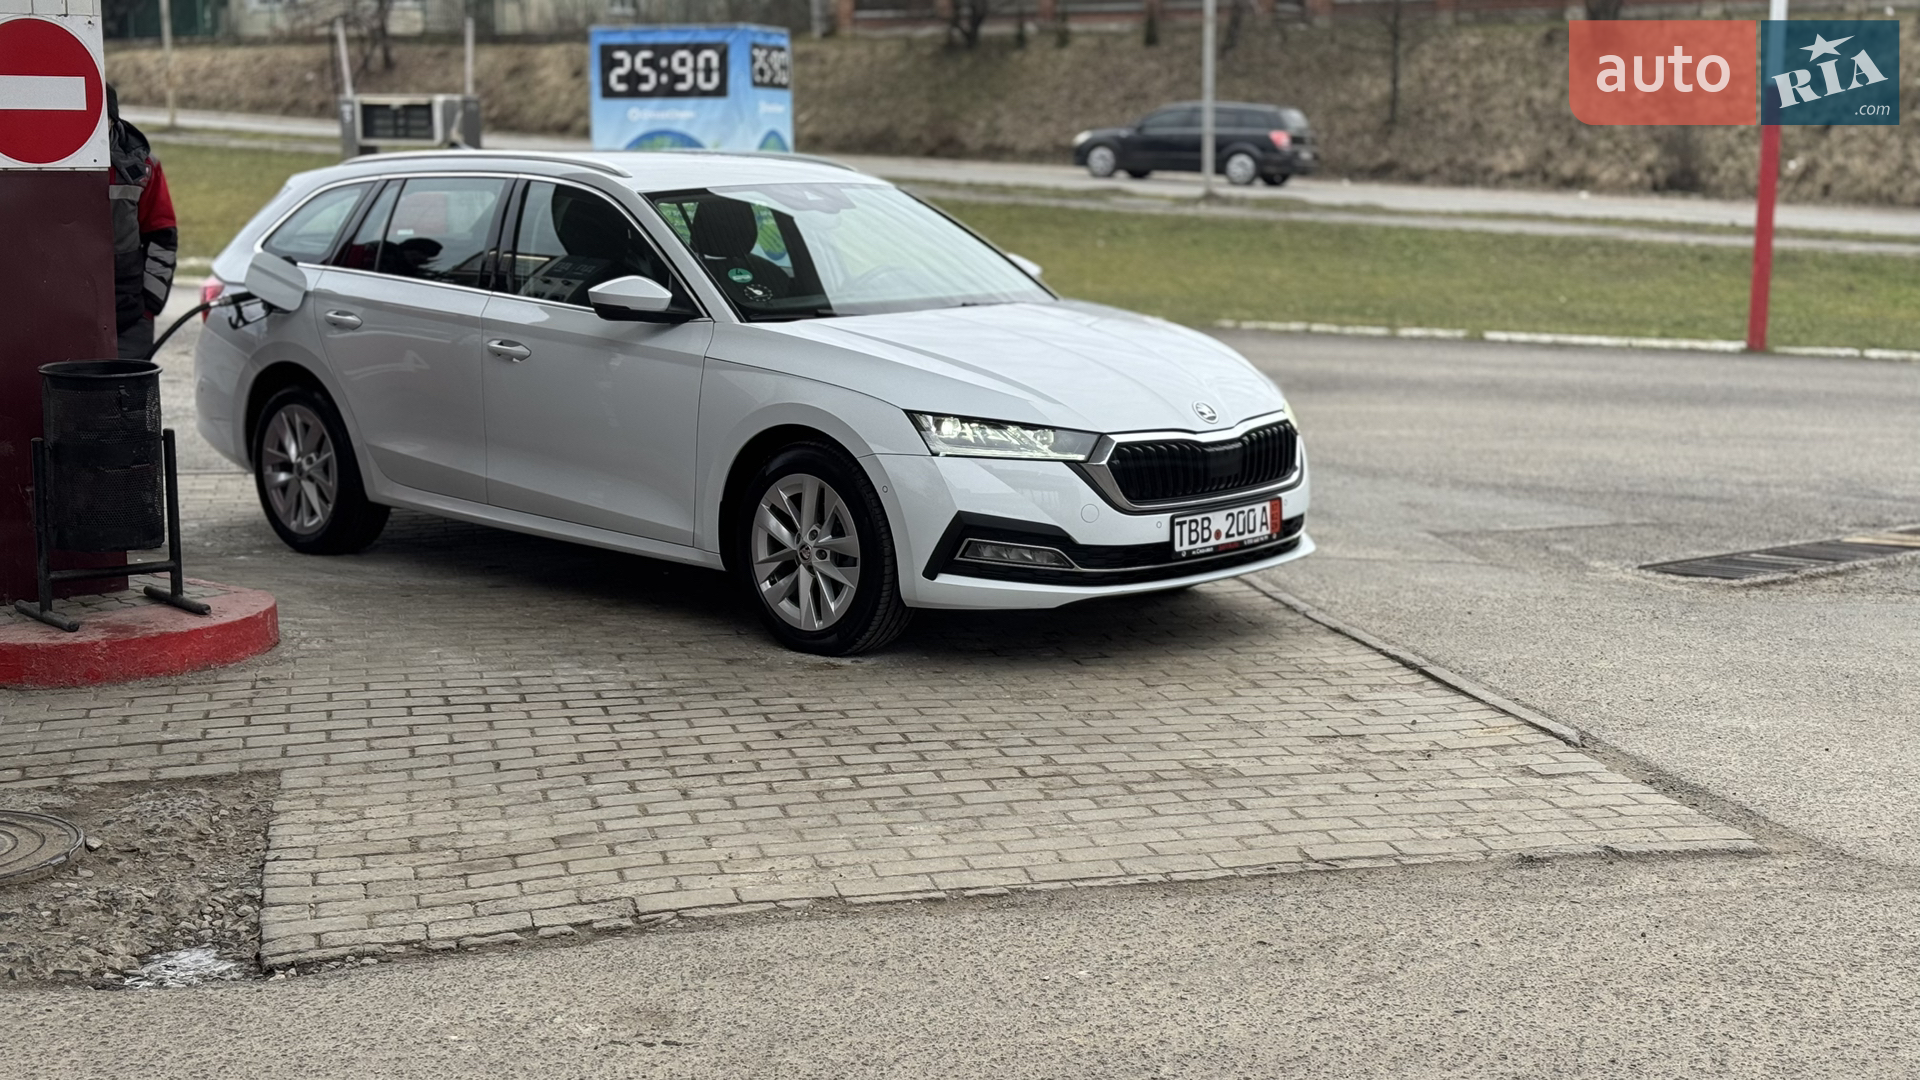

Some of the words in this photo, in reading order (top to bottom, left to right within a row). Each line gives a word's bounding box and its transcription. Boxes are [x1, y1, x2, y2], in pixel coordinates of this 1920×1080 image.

[608, 49, 720, 92] 25:90
[1175, 516, 1212, 548] TBB
[1225, 508, 1257, 539] 200
[1260, 505, 1269, 533] A
